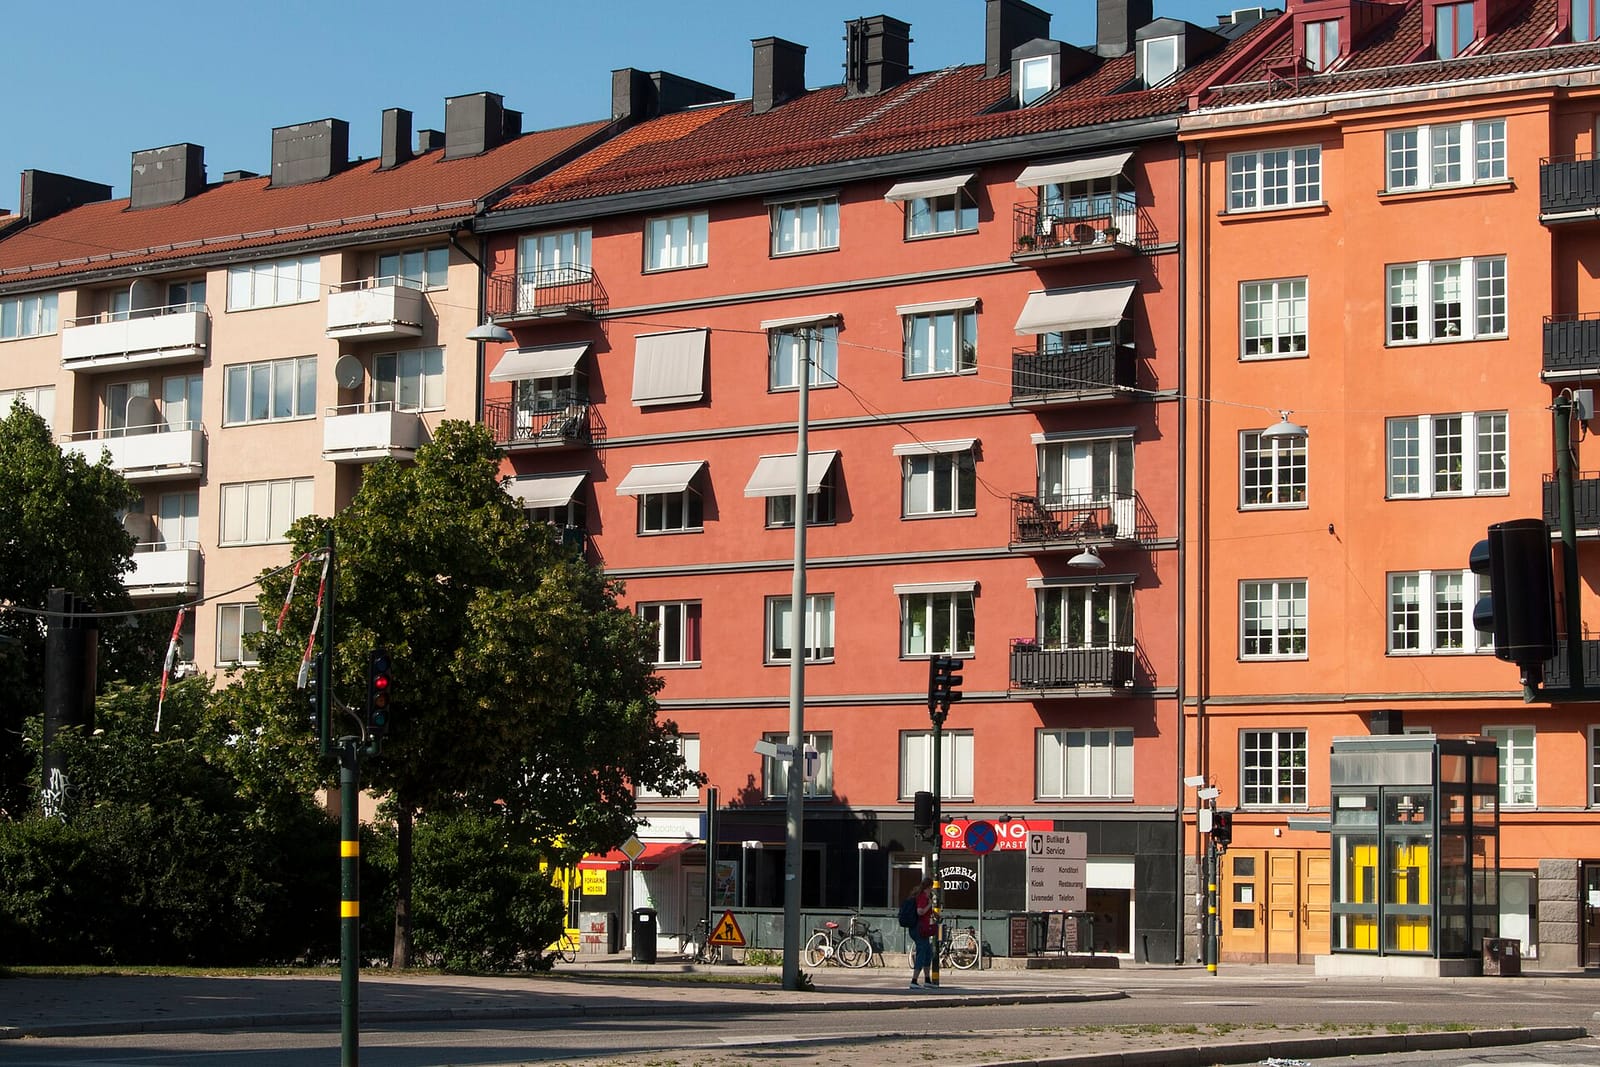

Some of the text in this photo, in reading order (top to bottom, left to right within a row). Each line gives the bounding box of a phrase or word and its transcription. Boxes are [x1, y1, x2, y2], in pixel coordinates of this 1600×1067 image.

[945, 840, 1027, 849] PIZZ PAST
[1046, 847, 1066, 855] Service
[940, 866, 977, 882] IZZERIA
[943, 880, 970, 890] DINO
